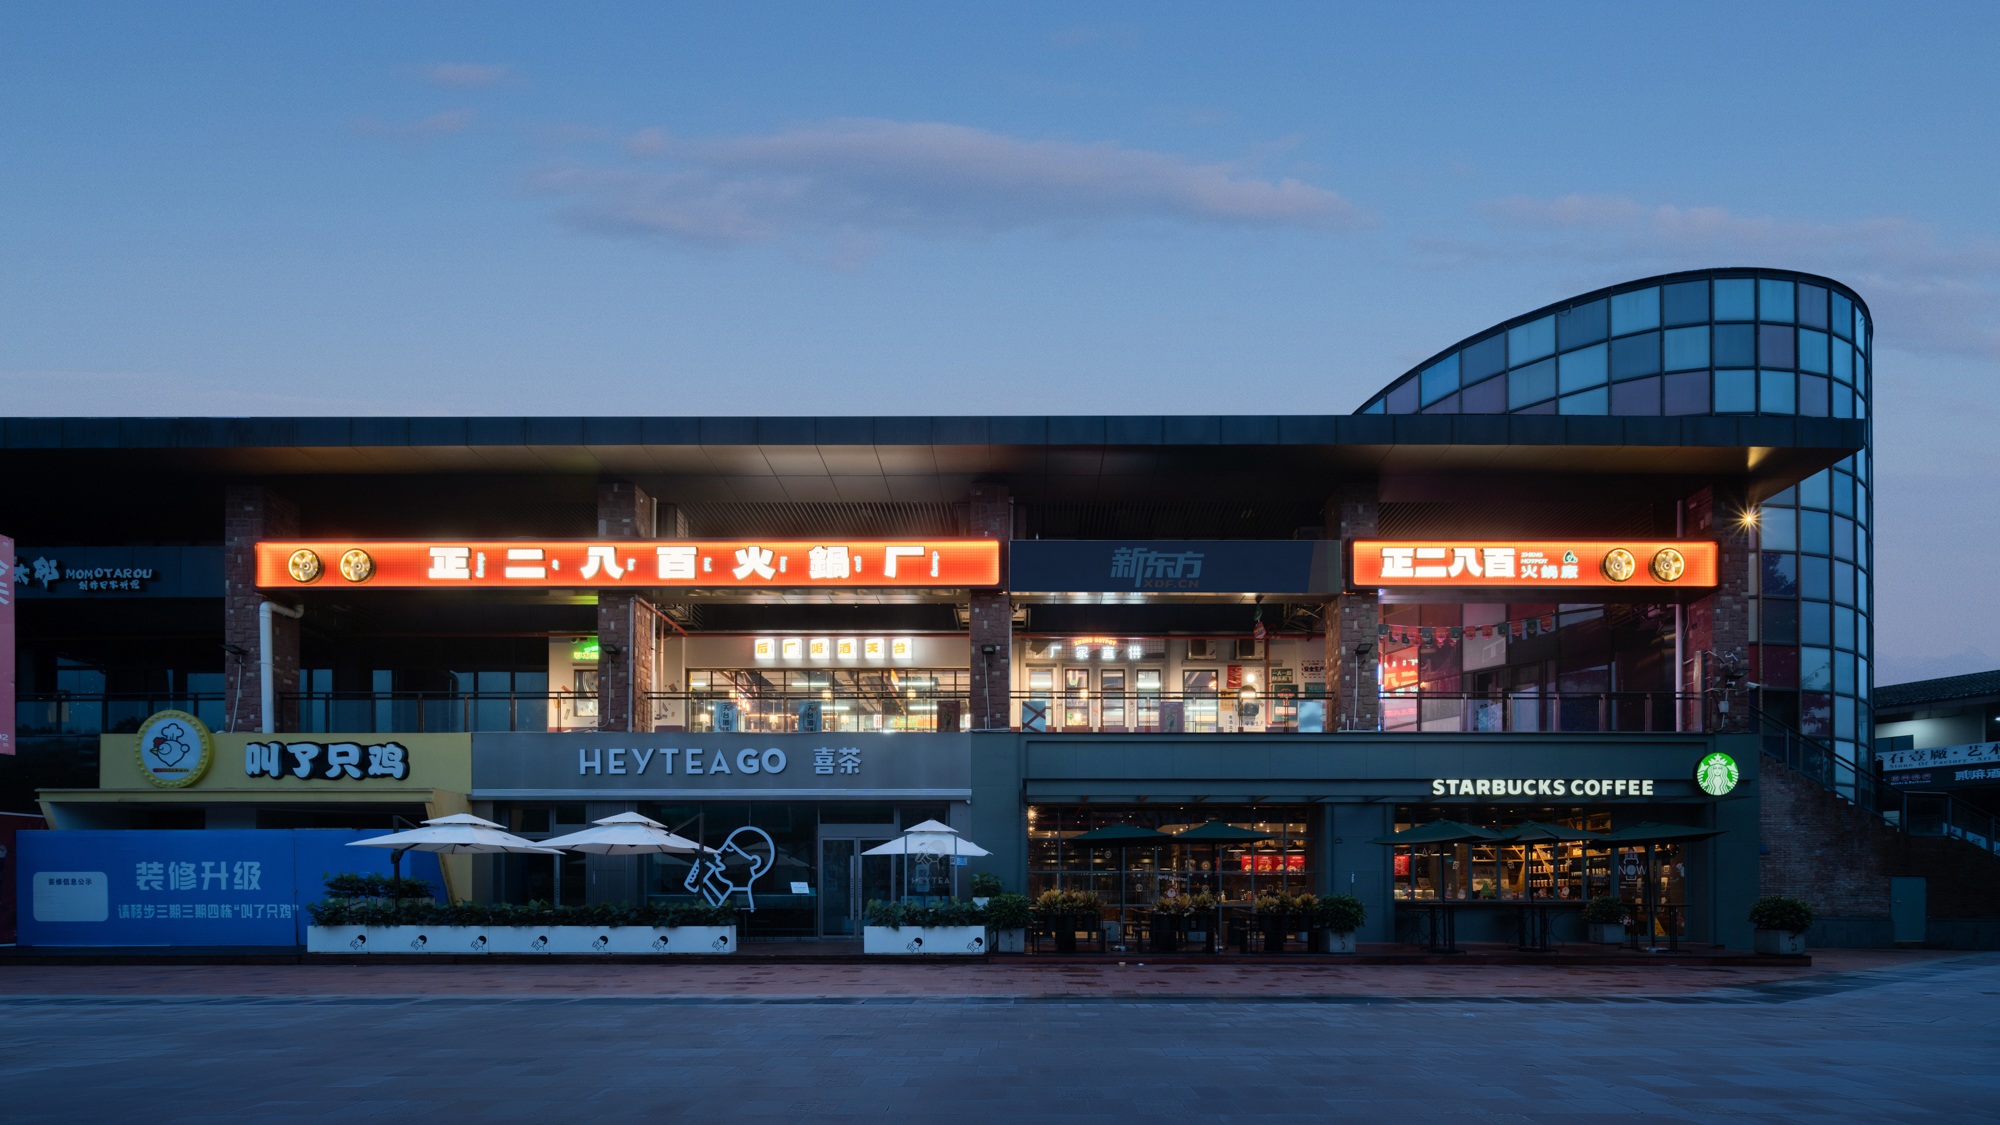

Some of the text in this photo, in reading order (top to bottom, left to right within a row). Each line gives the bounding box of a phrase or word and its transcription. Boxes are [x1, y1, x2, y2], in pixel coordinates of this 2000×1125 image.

[1110, 547, 1205, 587] 新东方
[1380, 547, 1516, 578] 正二八百
[65, 567, 153, 580] MOMOTAROU
[1143, 579, 1199, 588] XDF.CN
[756, 641, 906, 654] 后厂喝酒天台
[1094, 637, 1118, 646] HOTPOT
[1050, 645, 1142, 660] 厂家直供
[245, 741, 408, 779] 叫了只鸡
[579, 747, 786, 775] HEYTEAGO
[813, 746, 862, 776] 喜茶
[1431, 778, 1654, 796] STARBUCKS COFFEE
[48, 877, 93, 886] 装修信息公示
[135, 860, 261, 891] 装修升级
[911, 876, 950, 884] HEYTEA
[117, 903, 299, 919] 请移步三期三期四栋“叫了只鸡”
